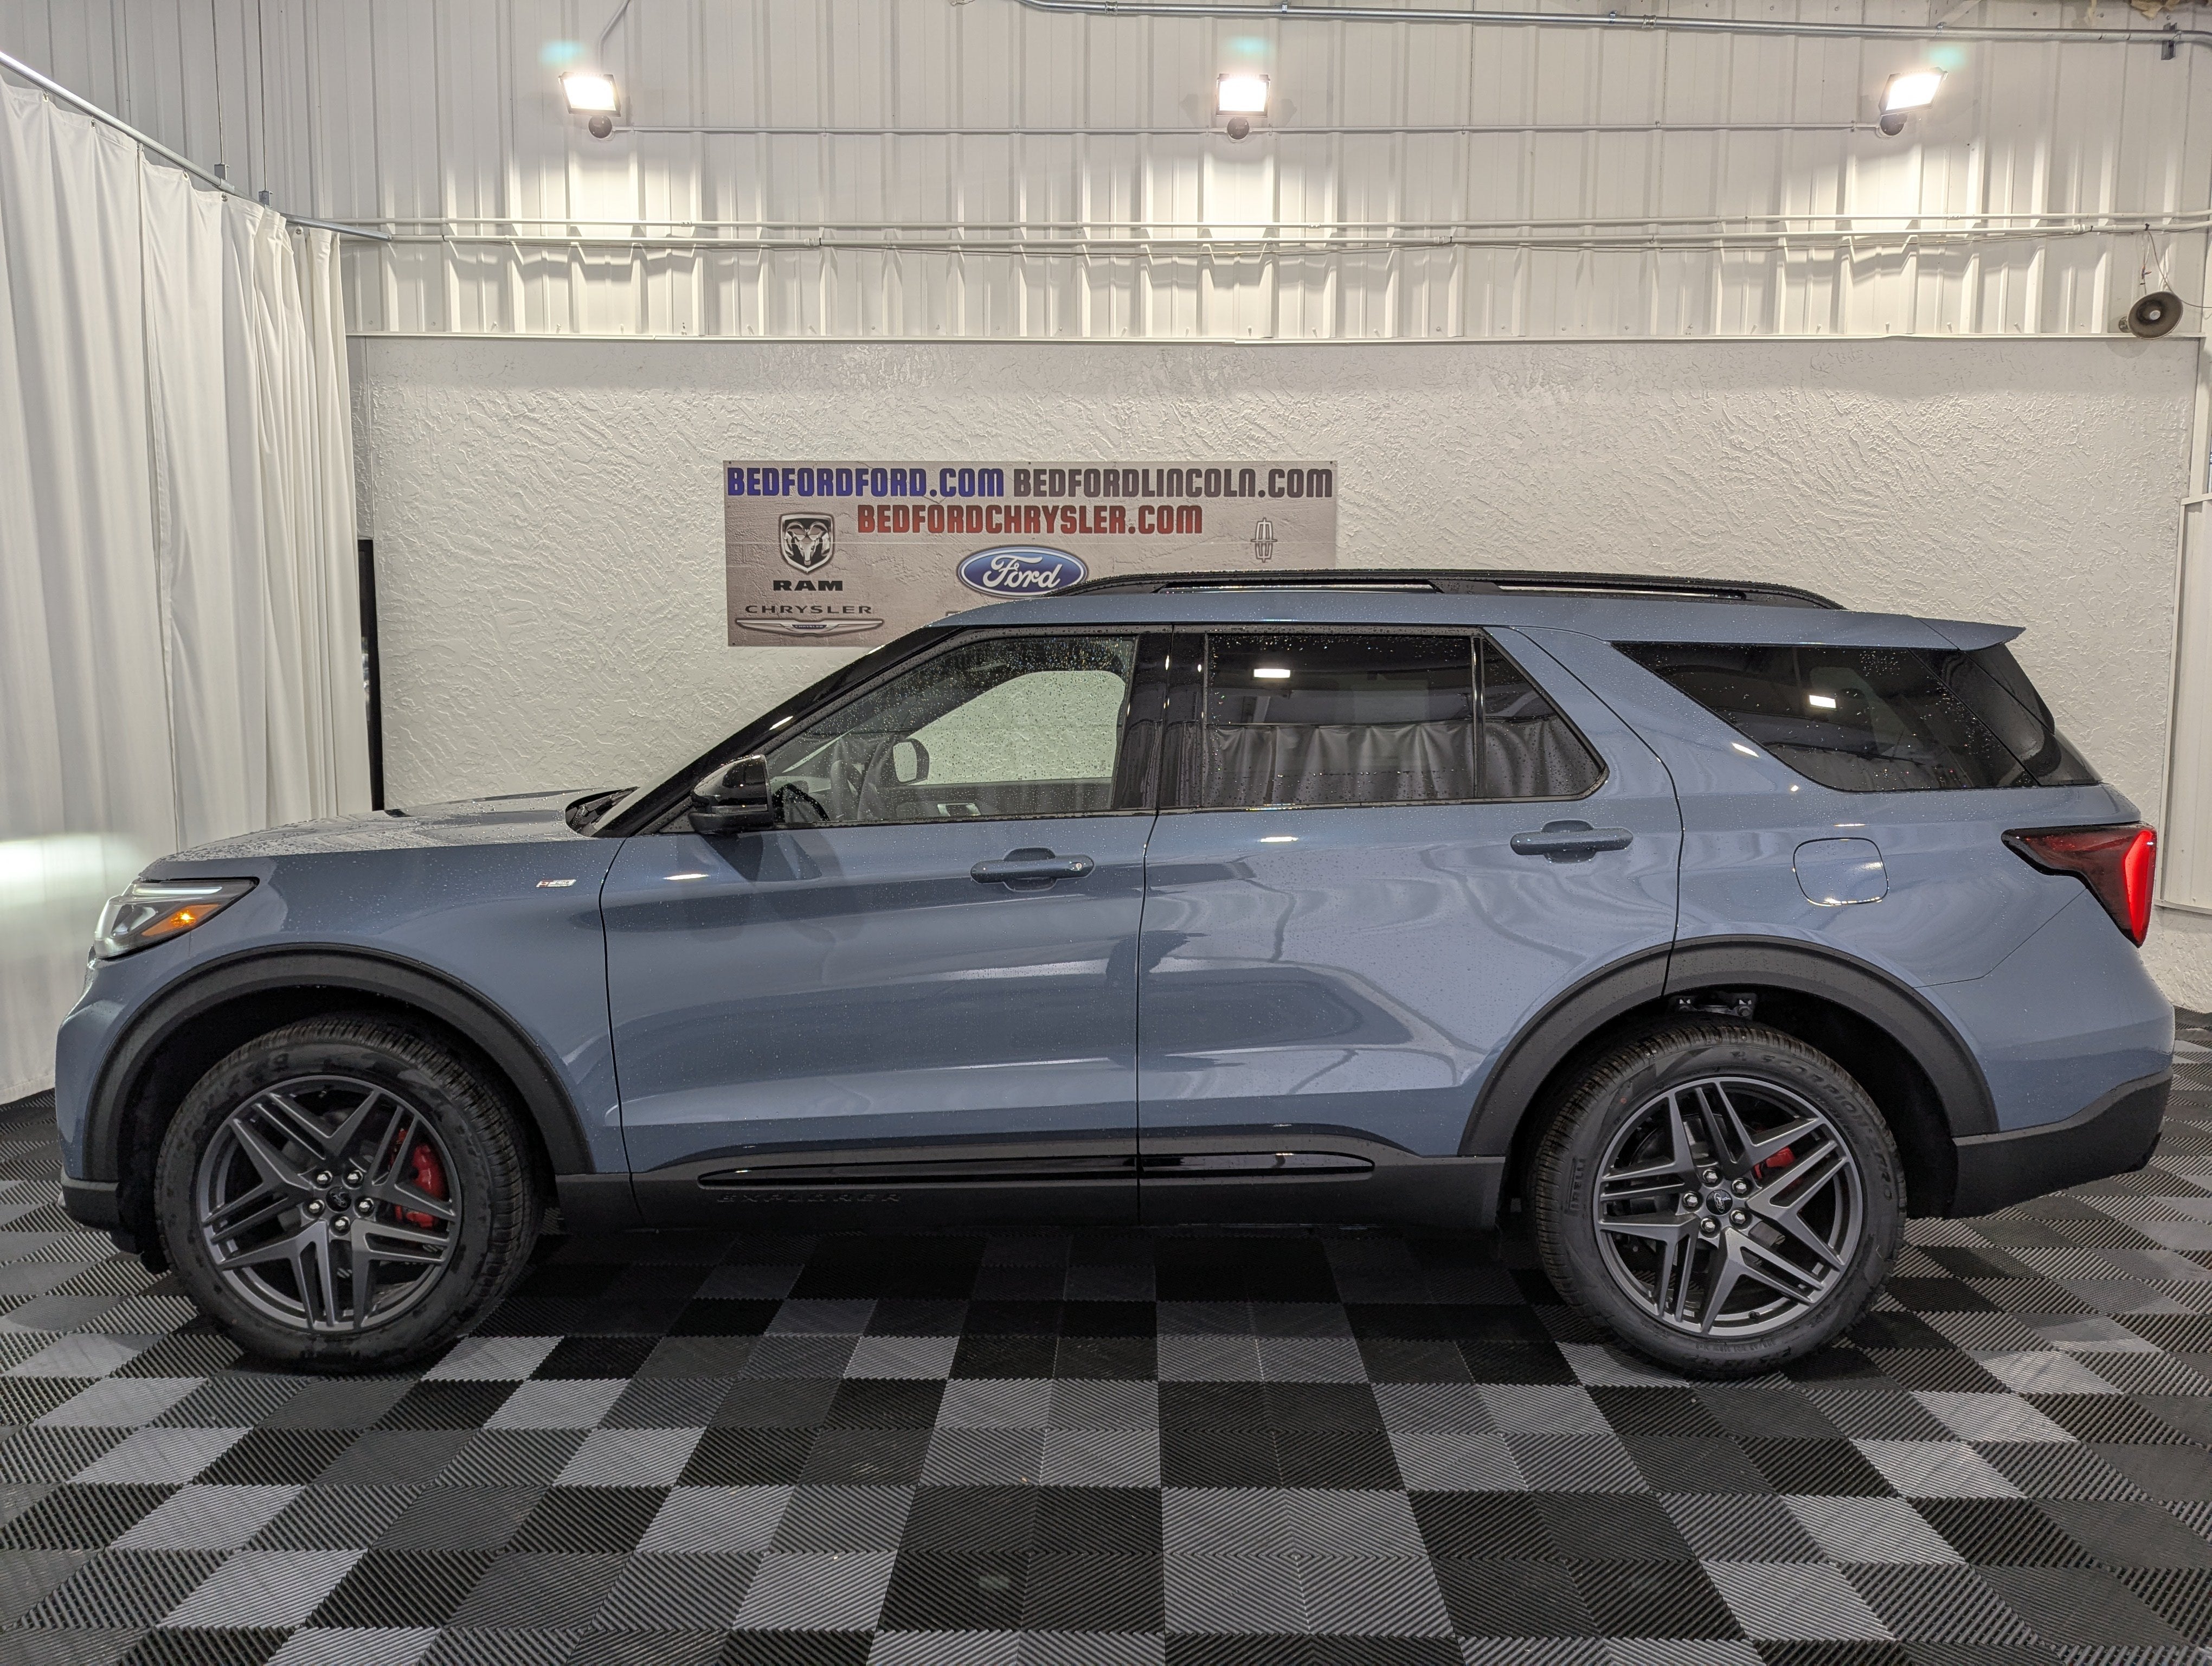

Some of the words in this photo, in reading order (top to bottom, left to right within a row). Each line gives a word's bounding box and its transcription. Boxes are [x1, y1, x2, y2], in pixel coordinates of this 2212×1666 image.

[727, 467, 1004, 497] BEDFORDFORD.COM
[1013, 468, 1332, 498] BEDFORDLINCOLN.COM
[857, 504, 1203, 535] BEDFORDCHRYSLER.COM
[982, 554, 1063, 588] Ford
[773, 580, 844, 591] RAM
[745, 605, 872, 614] CHRYSLER
[716, 1193, 901, 1202] EXPLORER
